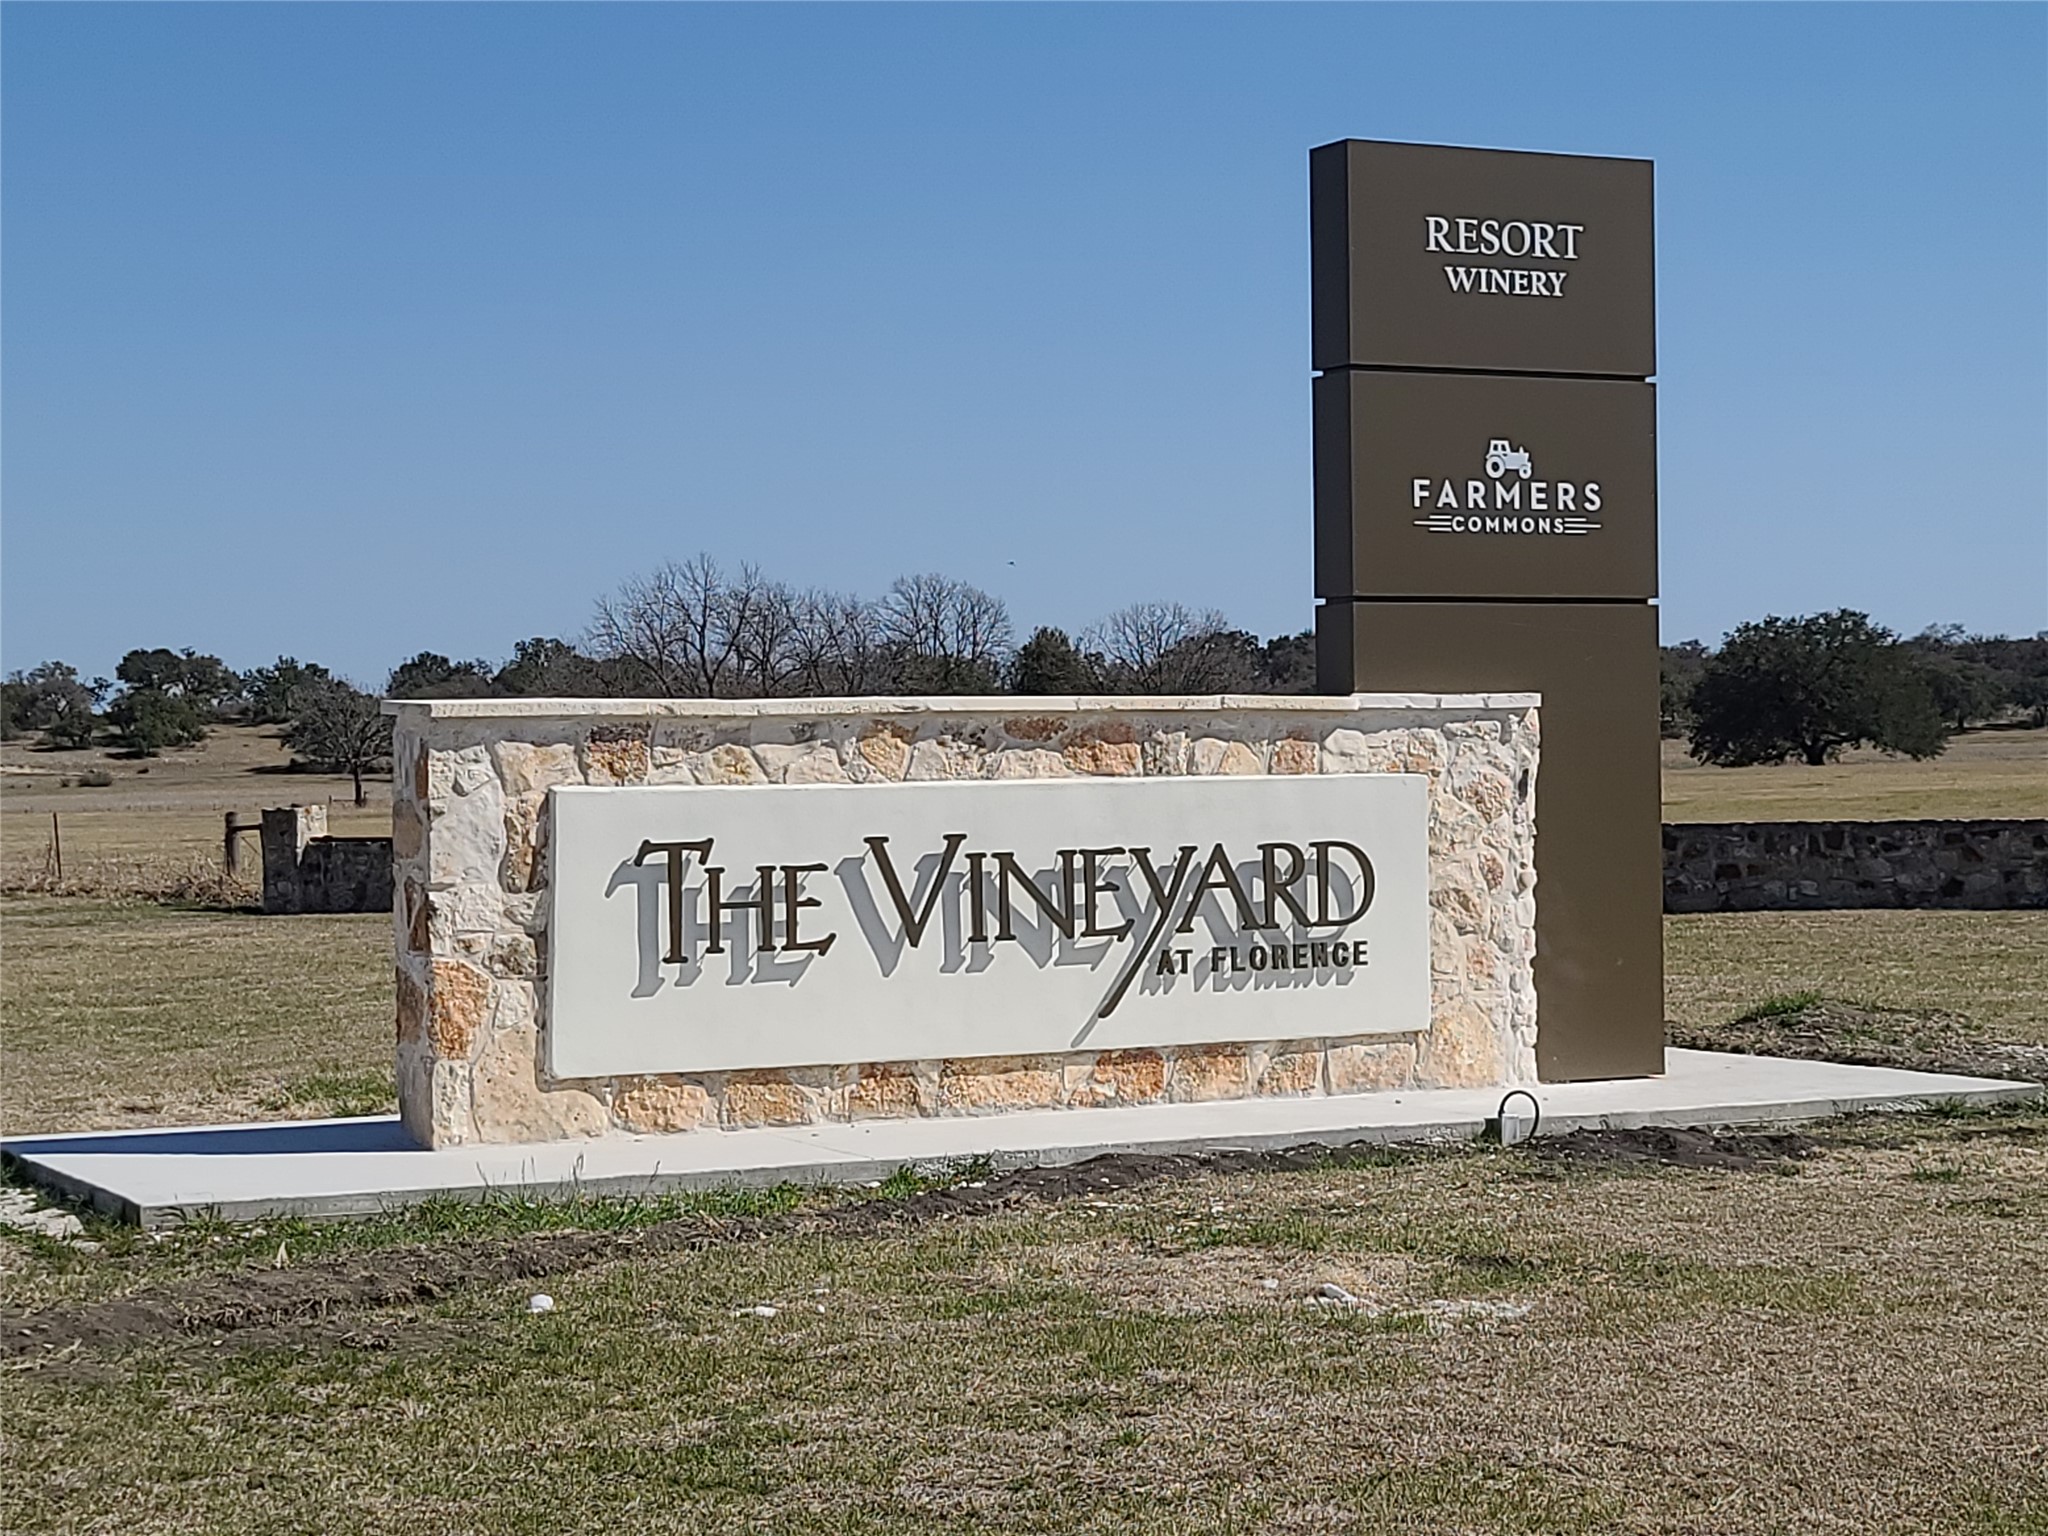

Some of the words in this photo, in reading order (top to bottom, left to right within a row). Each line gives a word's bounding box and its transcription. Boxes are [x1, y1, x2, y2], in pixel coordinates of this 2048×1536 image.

[1425, 216, 1584, 260] RESORT
[1444, 266, 1567, 297] WINERY
[1412, 479, 1602, 511] FARMERS
[1451, 516, 1565, 534] COMMONS
[635, 837, 836, 965] THE
[863, 832, 1376, 1020] VINEYARD
[1157, 945, 1191, 976] AT
[1211, 940, 1369, 973] FLORENCE
